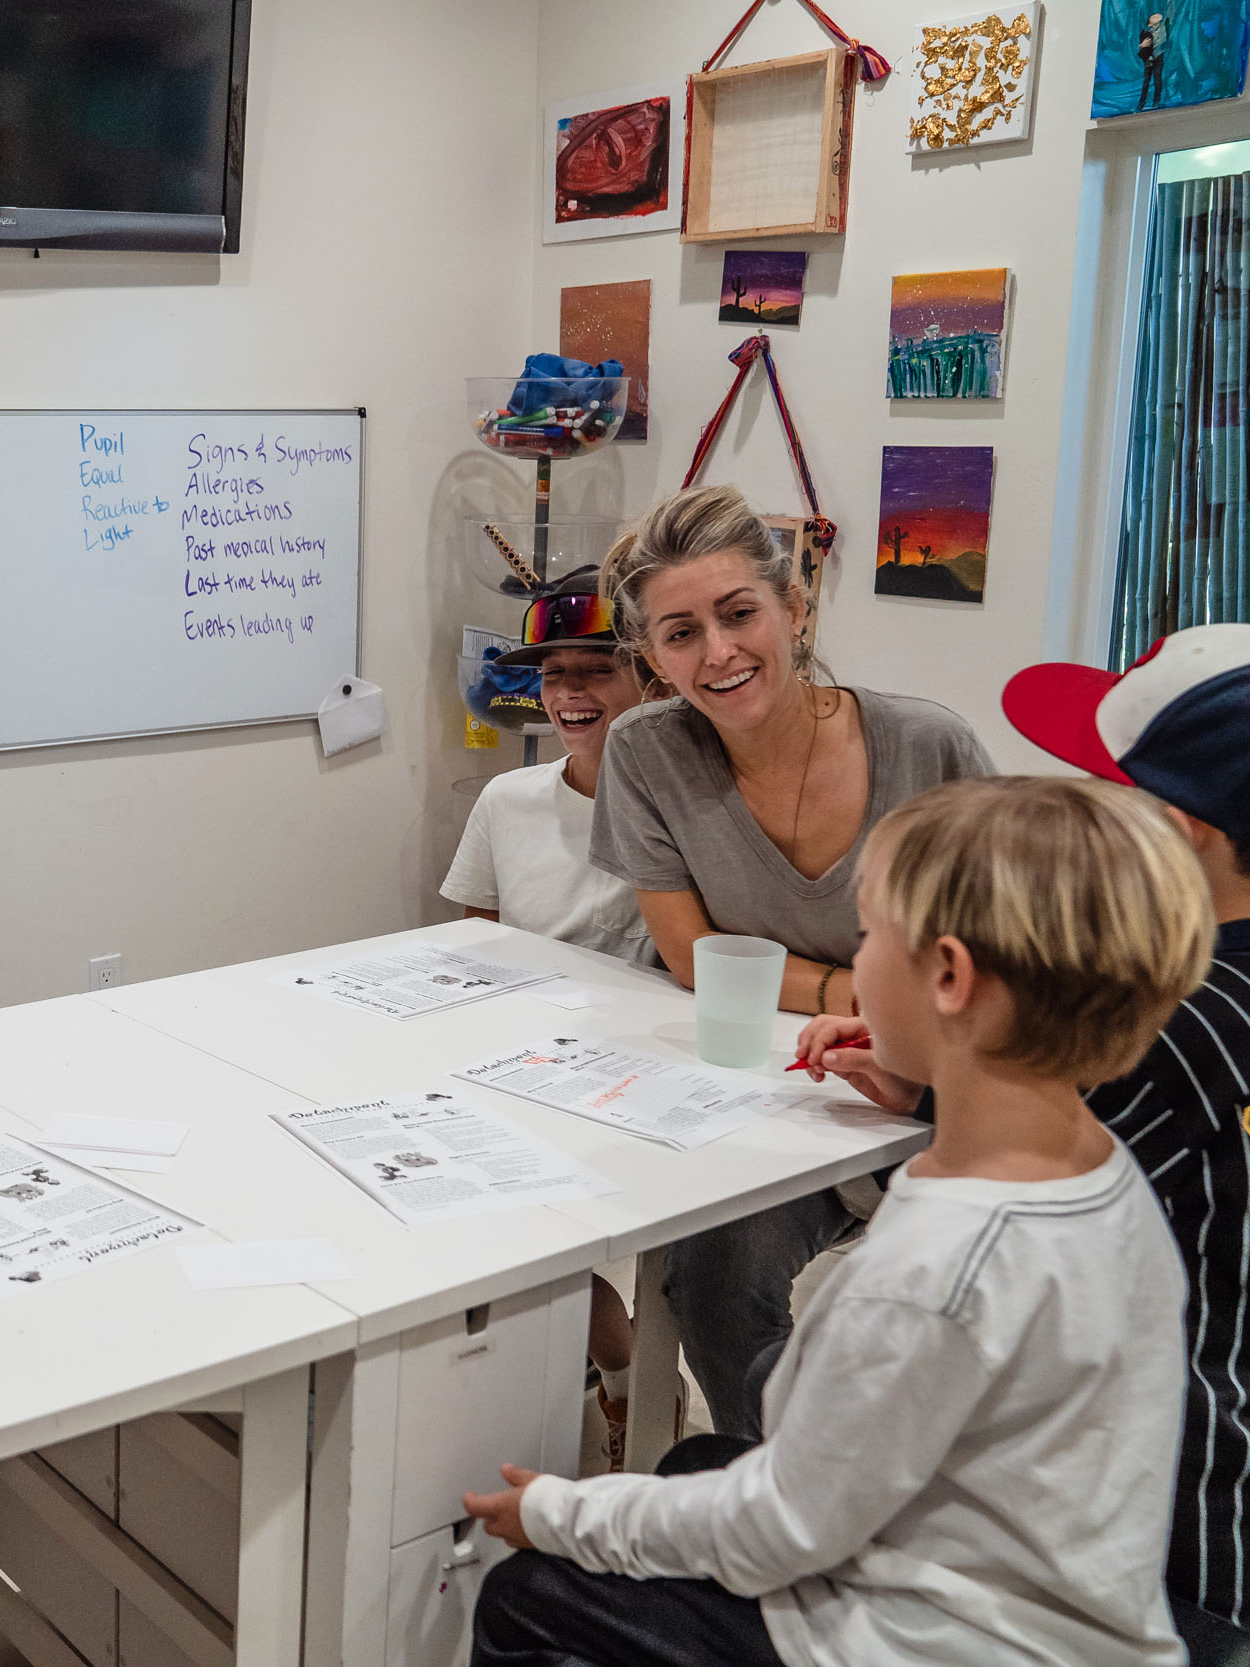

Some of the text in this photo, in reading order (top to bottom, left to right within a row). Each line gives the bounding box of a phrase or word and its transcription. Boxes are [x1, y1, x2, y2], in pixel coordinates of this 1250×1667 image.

[79, 423, 125, 457] Pupil
[187, 433, 249, 474] Signs
[275, 436, 352, 476] Symptoms
[79, 460, 124, 488] Equal
[185, 472, 265, 504] Allergies
[82, 495, 170, 522] Reactive to
[182, 500, 293, 531] Medications
[84, 523, 133, 551] Light
[185, 535, 216, 562] Past
[279, 536, 326, 560] history
[185, 568, 323, 598] Last time they ate
[184, 610, 314, 644] Events leading up
